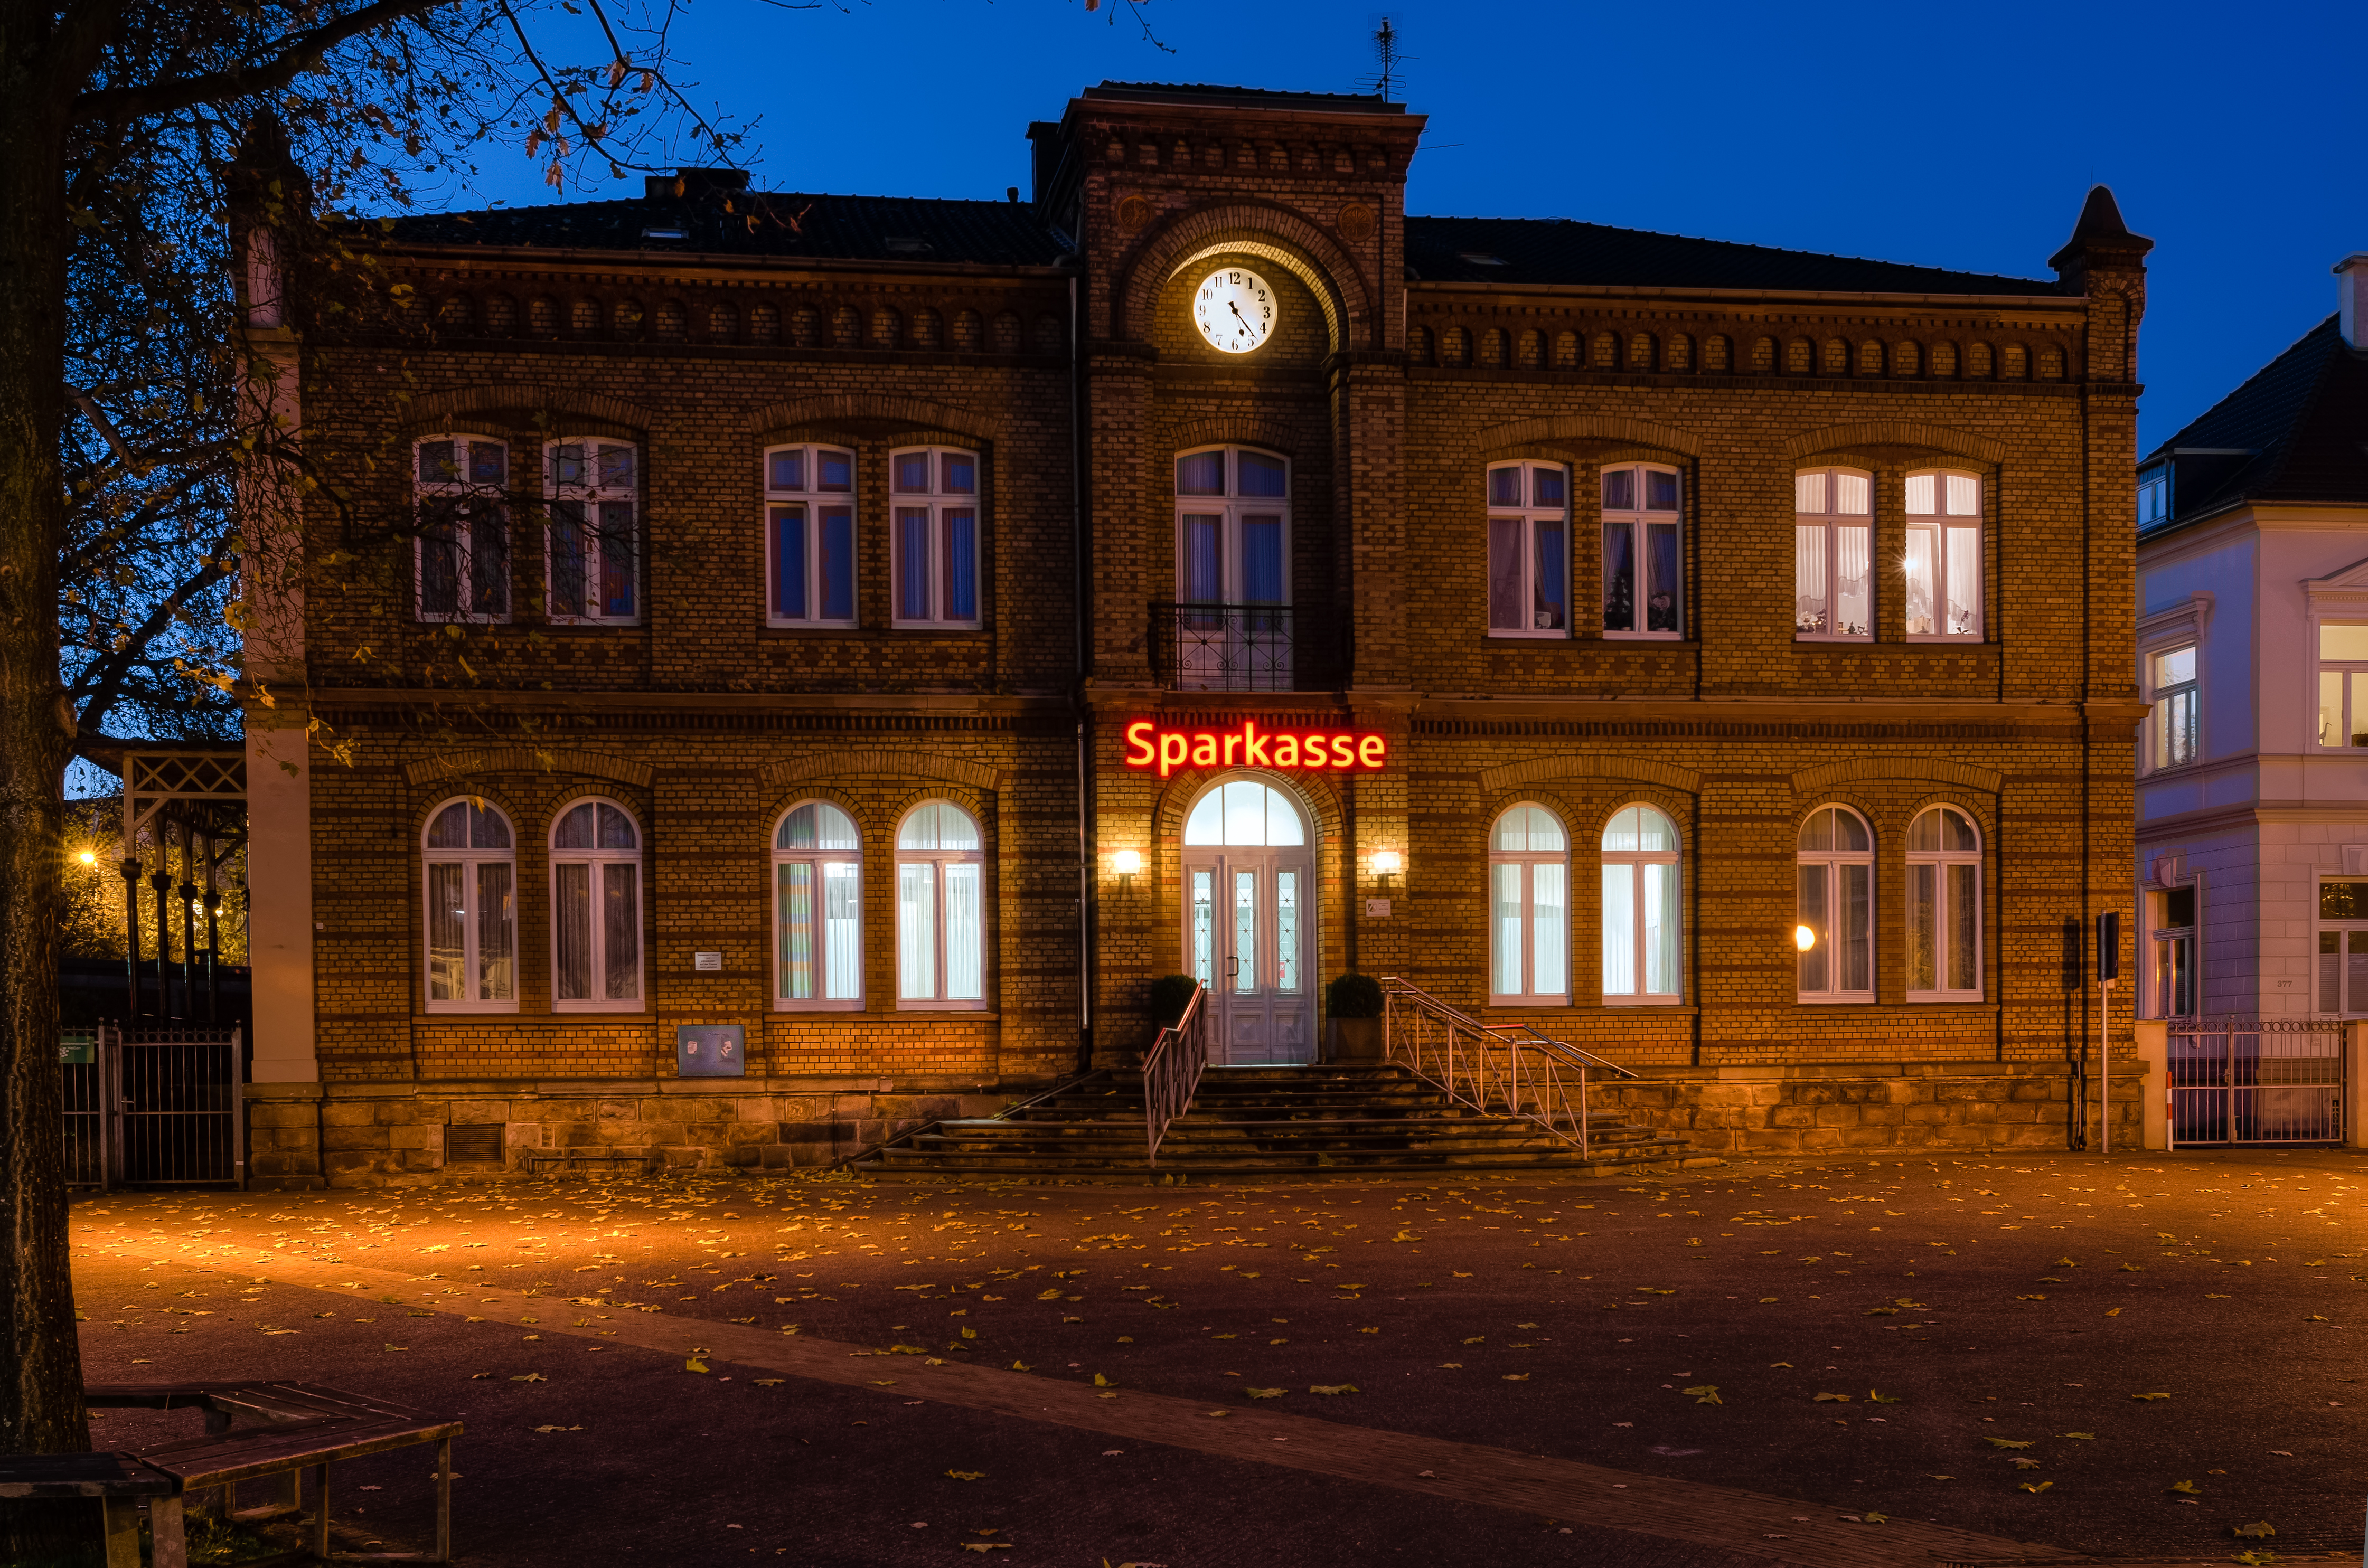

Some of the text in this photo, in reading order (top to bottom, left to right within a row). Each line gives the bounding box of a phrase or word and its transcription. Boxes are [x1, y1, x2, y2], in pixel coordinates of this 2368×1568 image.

[1215, 277, 1223, 288] 11
[1228, 272, 1241, 284] 12
[1248, 277, 1253, 289] 1
[1202, 289, 1213, 300] 10
[1258, 289, 1265, 301] 2
[1199, 305, 1206, 317] 9
[1263, 306, 1271, 318] 3
[1204, 322, 1210, 333] 8
[1260, 322, 1266, 334] 4
[1216, 334, 1223, 346] 7
[1232, 338, 1238, 350] 6
[1248, 335, 1254, 346] 5
[1126, 722, 1385, 776] Sparkasse
